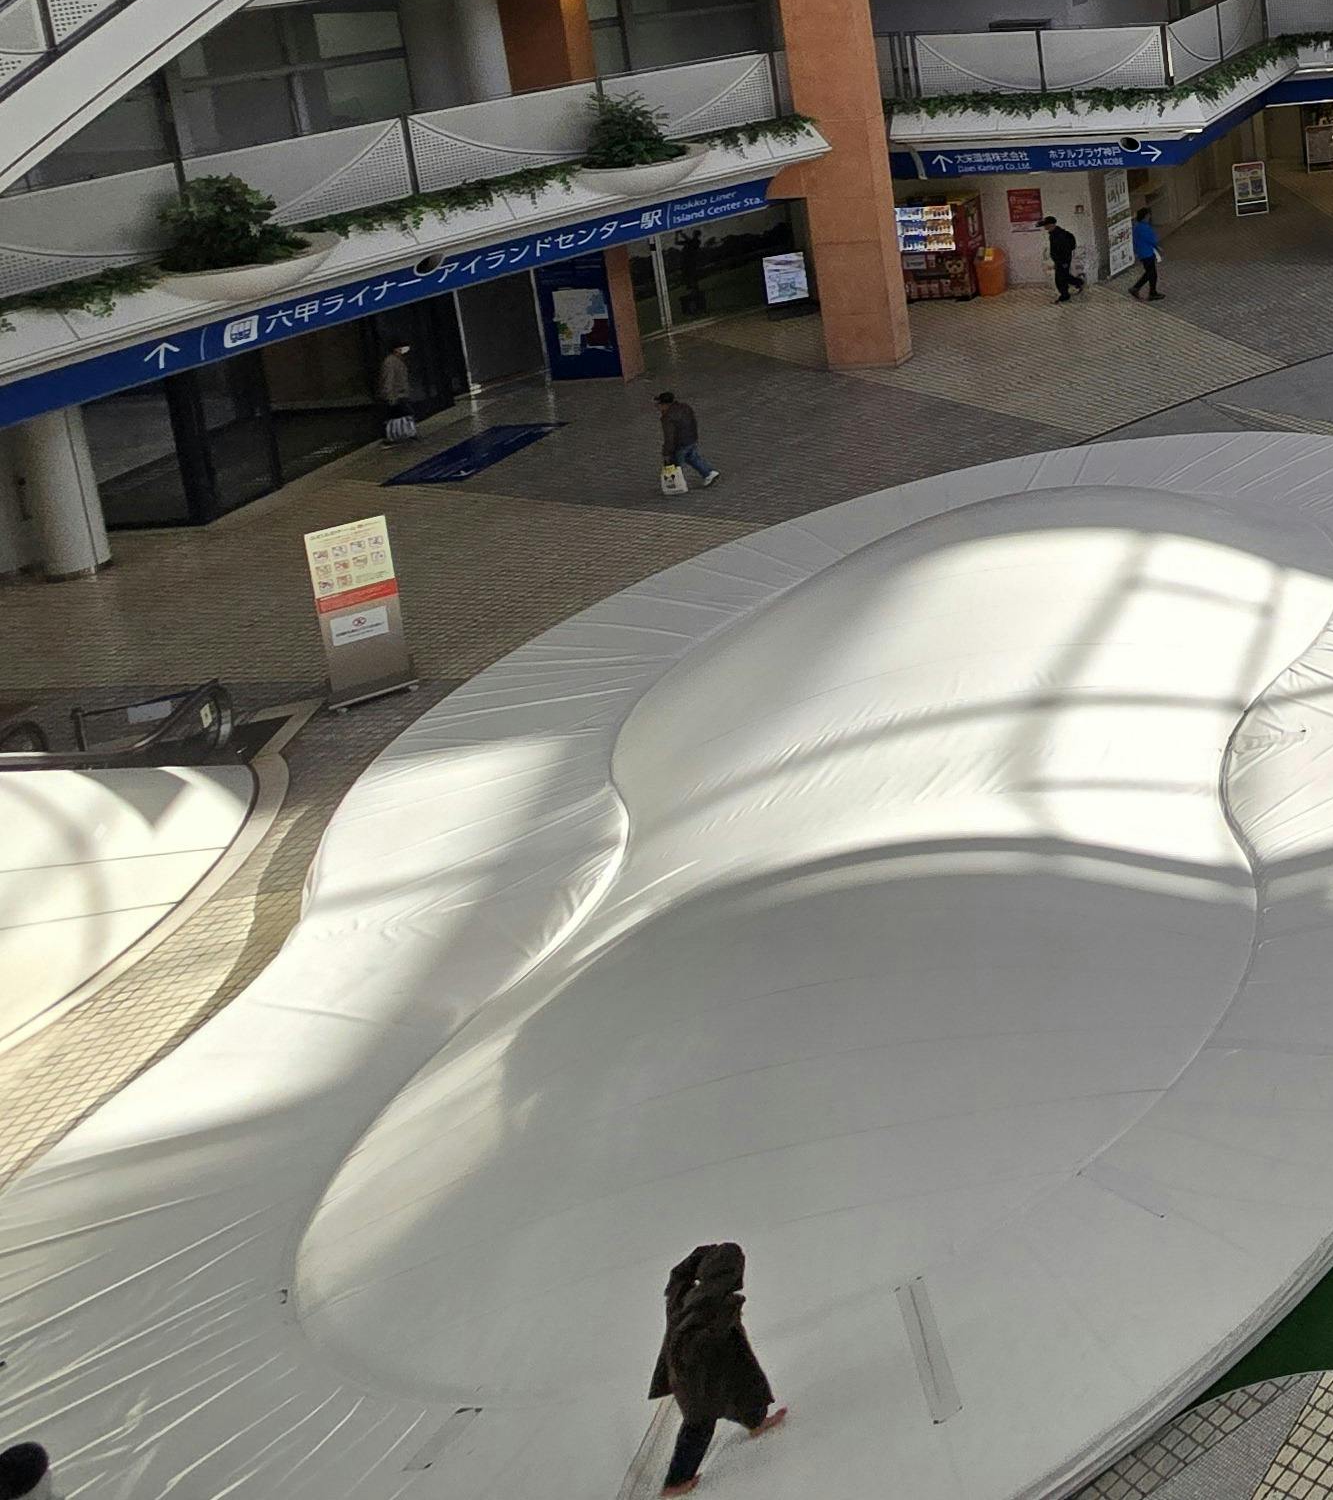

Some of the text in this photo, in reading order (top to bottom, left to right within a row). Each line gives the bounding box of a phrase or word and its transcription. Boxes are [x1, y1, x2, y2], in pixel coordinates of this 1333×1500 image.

[1051, 157, 1124, 168] HOTEL PLAZA KOBE
[673, 190, 738, 212] Rokko Liner
[673, 197, 764, 224] Island Center Sta.
[265, 209, 663, 334] 六甲ライナー アイランドセンター駅
